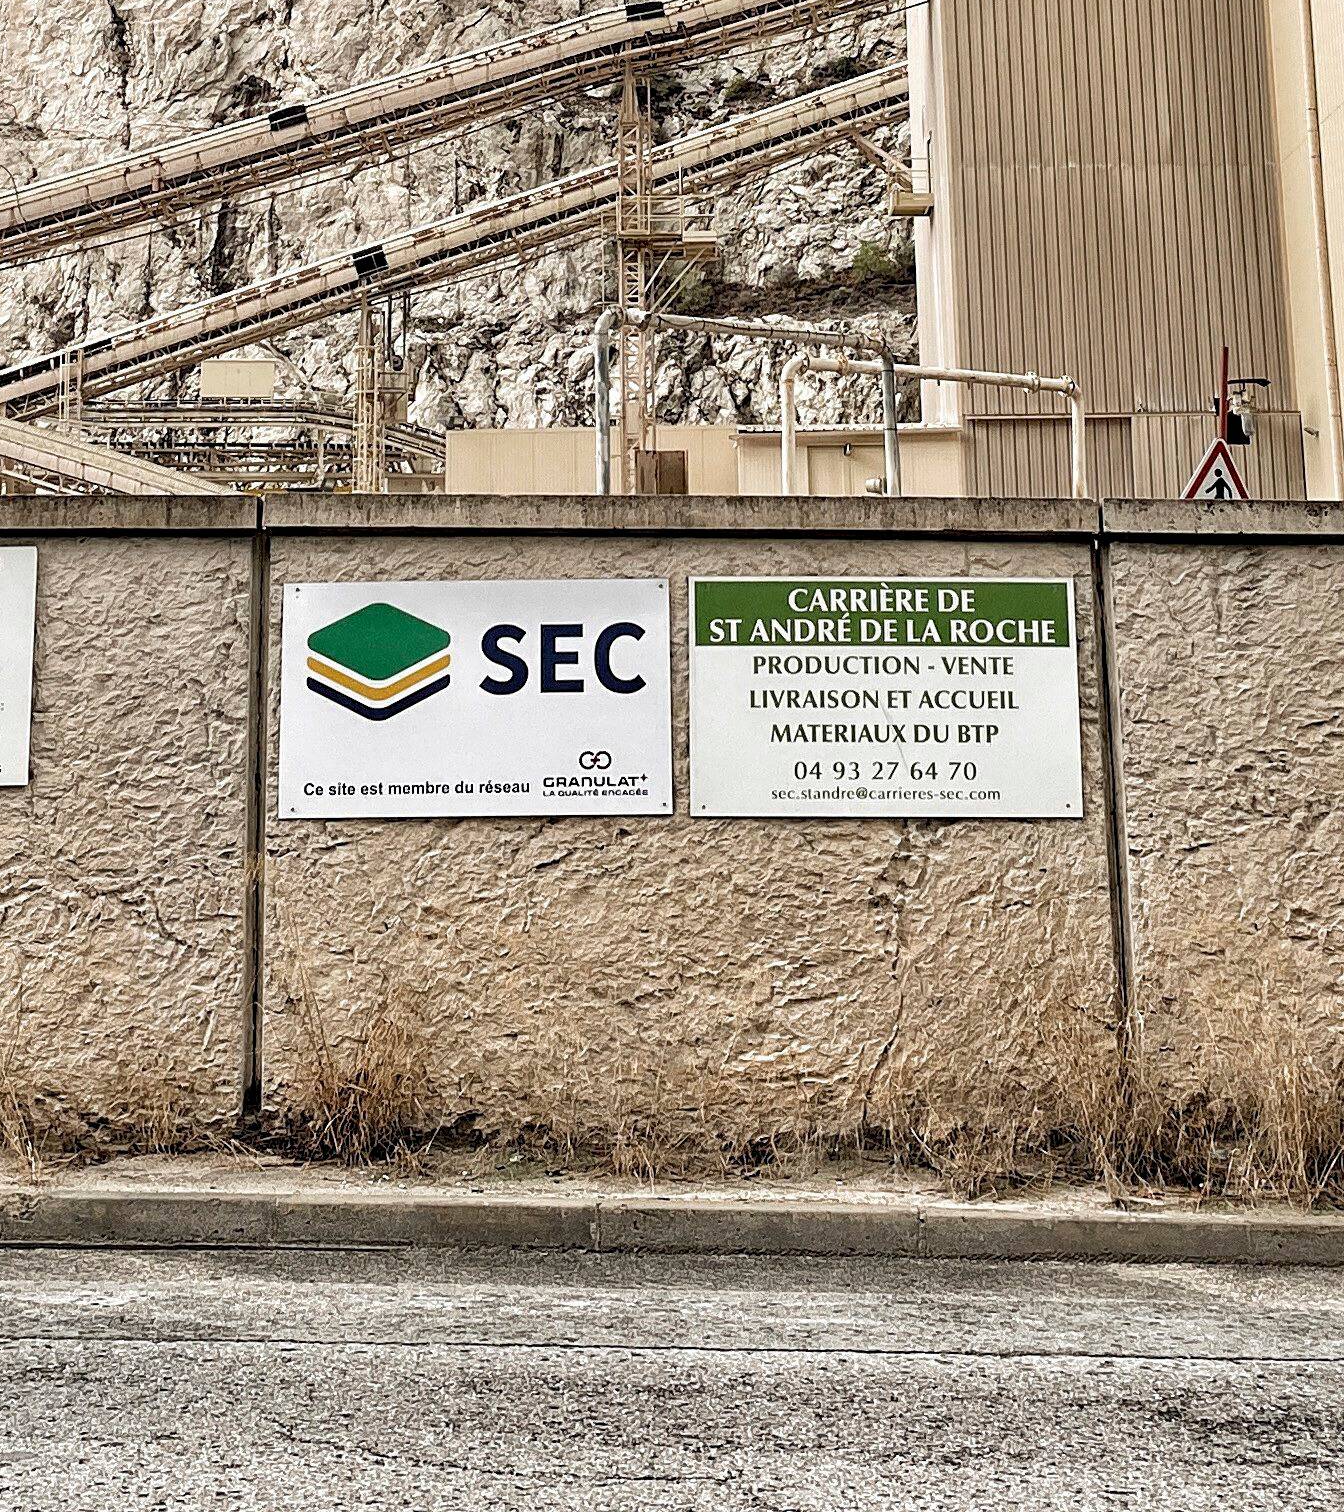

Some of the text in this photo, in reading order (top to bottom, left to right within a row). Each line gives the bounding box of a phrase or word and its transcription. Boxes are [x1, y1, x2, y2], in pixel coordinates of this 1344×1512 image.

[788, 583, 976, 613] CARRIÈRE DE
[709, 613, 1056, 644] ST ANDRÉ DE LA ROCHE
[479, 622, 646, 695] SEC
[753, 655, 921, 675] PRODUCTION
[942, 656, 1014, 675] VENTE
[750, 689, 1019, 709] LIVRAISON ET ACCUEIL
[770, 724, 999, 743] MATERIAUX DU BTP
[794, 761, 977, 780] 04 93 27 64 70
[303, 780, 530, 796] Ce site est membre du réseau
[771, 786, 1001, 800] sec.standre@carrieres-sec.com
